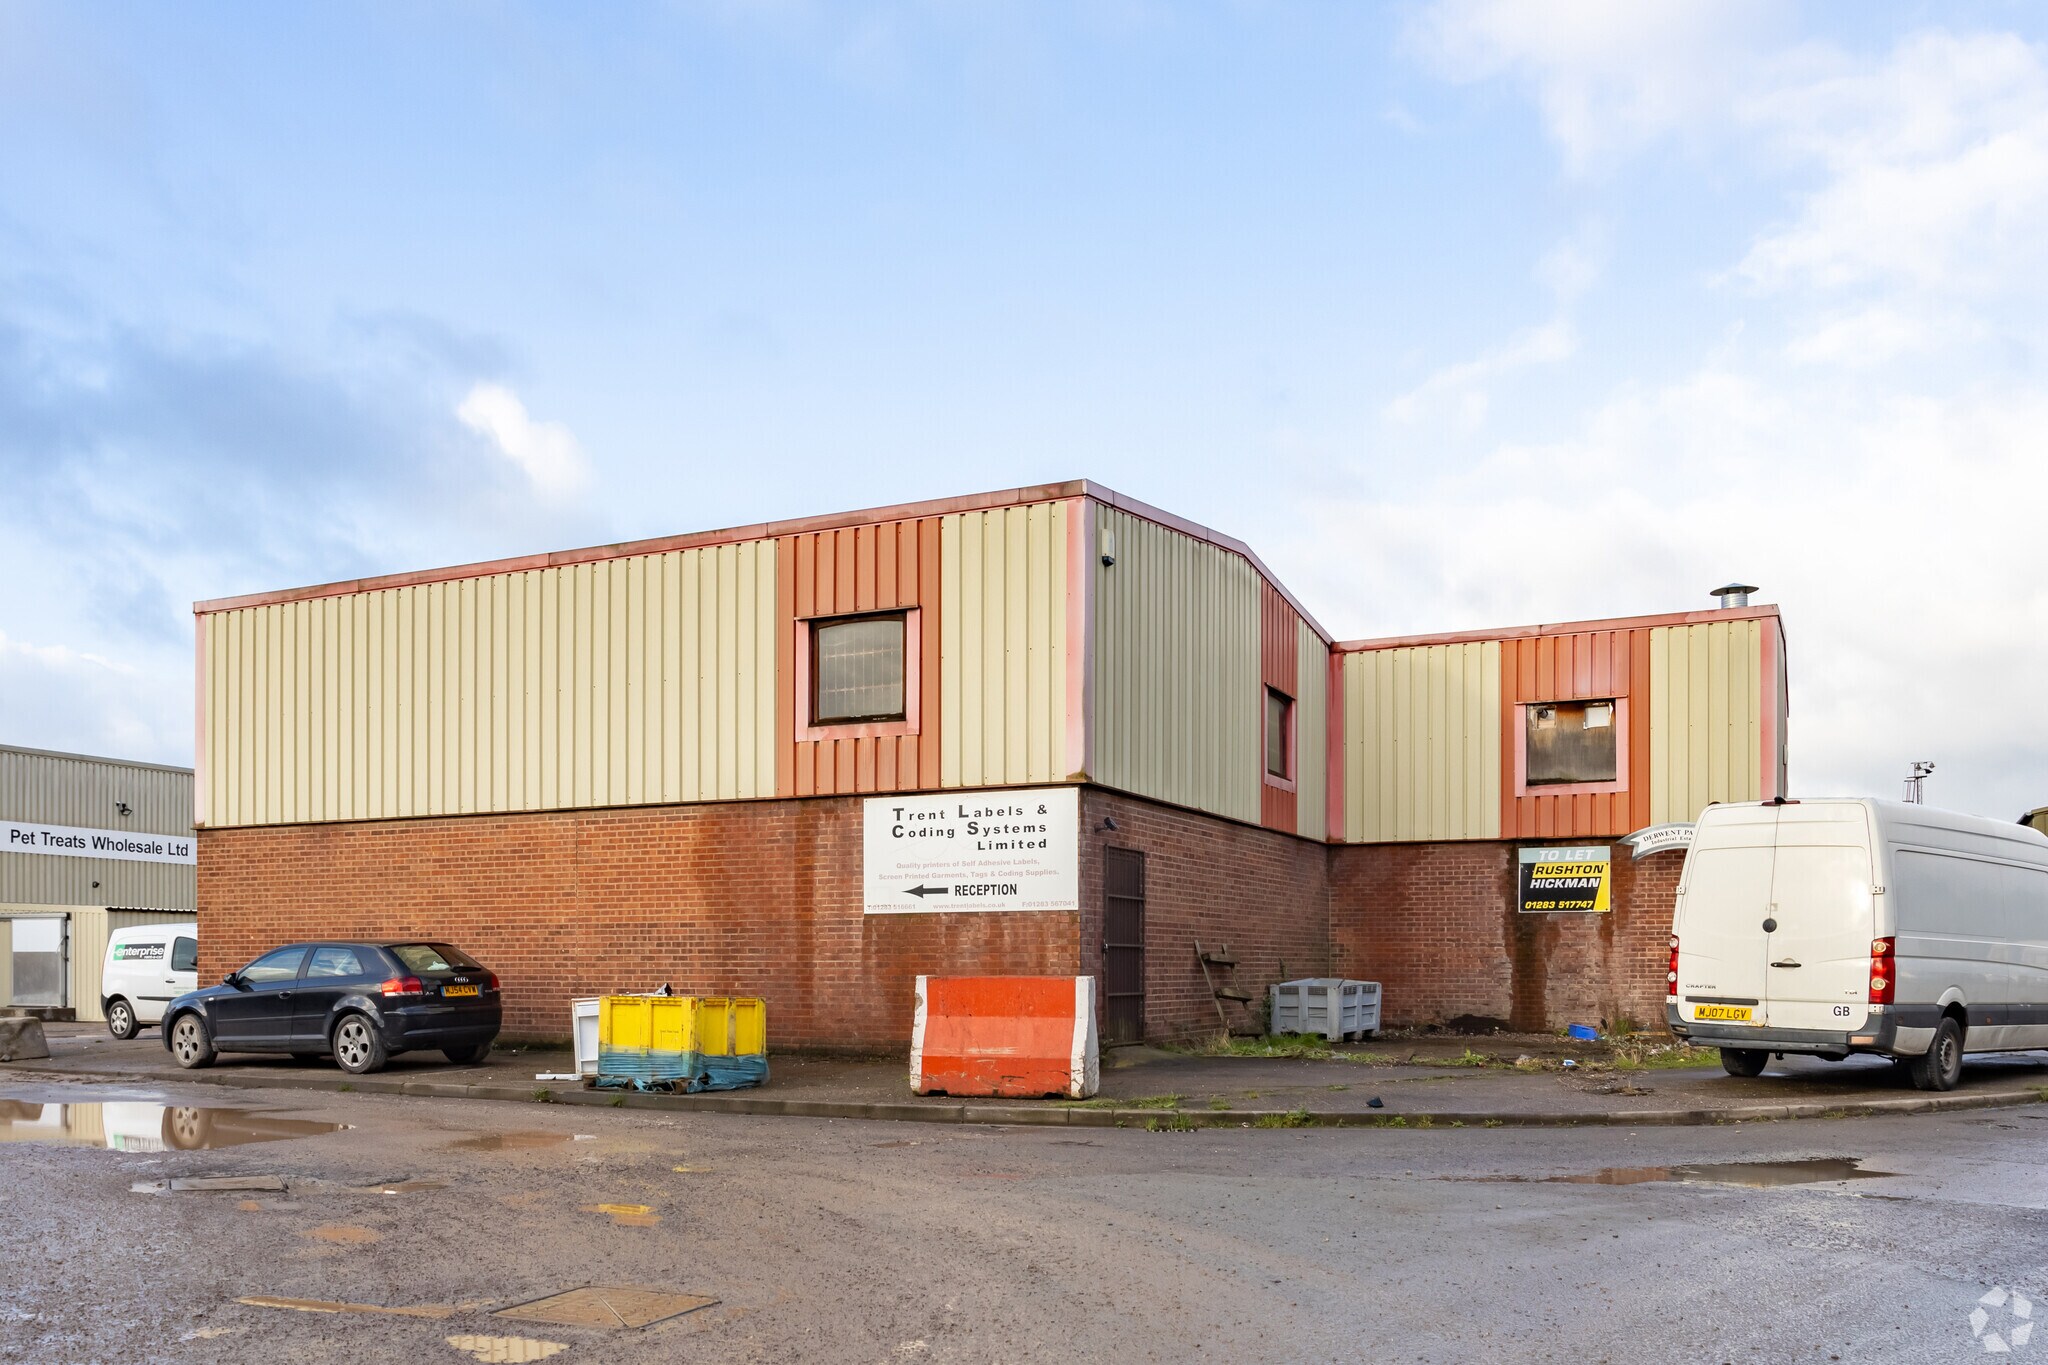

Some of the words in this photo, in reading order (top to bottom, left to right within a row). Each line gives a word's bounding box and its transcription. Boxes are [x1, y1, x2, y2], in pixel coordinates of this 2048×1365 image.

[892, 808, 945, 821] Trent
[958, 805, 1023, 818] Labels
[1037, 804, 1048, 815] &
[892, 825, 955, 839] Coding
[967, 821, 1047, 837] Systems
[1642, 829, 1681, 842] DERWENT
[10, 829, 35, 845] Pet
[41, 831, 86, 849] Treats
[91, 836, 163, 854] Wholesale
[168, 842, 189, 857] Ltd
[977, 839, 1047, 851] Limited
[1650, 836, 1677, 845] Industrial
[1539, 850, 1559, 861] TO
[1565, 849, 1595, 861] LET
[896, 861, 920, 870] Quality
[922, 861, 951, 869] printers
[1535, 865, 1604, 875] RUSHTON
[998, 870, 1024, 878] Coding
[1025, 869, 1060, 878] Supplies.
[954, 883, 1017, 896] RECEPTION
[1530, 878, 1600, 889] HICKMAN
[1525, 901, 1556, 909] 01283
[1558, 900, 1594, 909] 517747
[114, 945, 164, 958] enterprise
[1698, 1007, 1724, 1018] MJ07
[1726, 1008, 1747, 1019] LGV
[1833, 1005, 1850, 1017] GB
